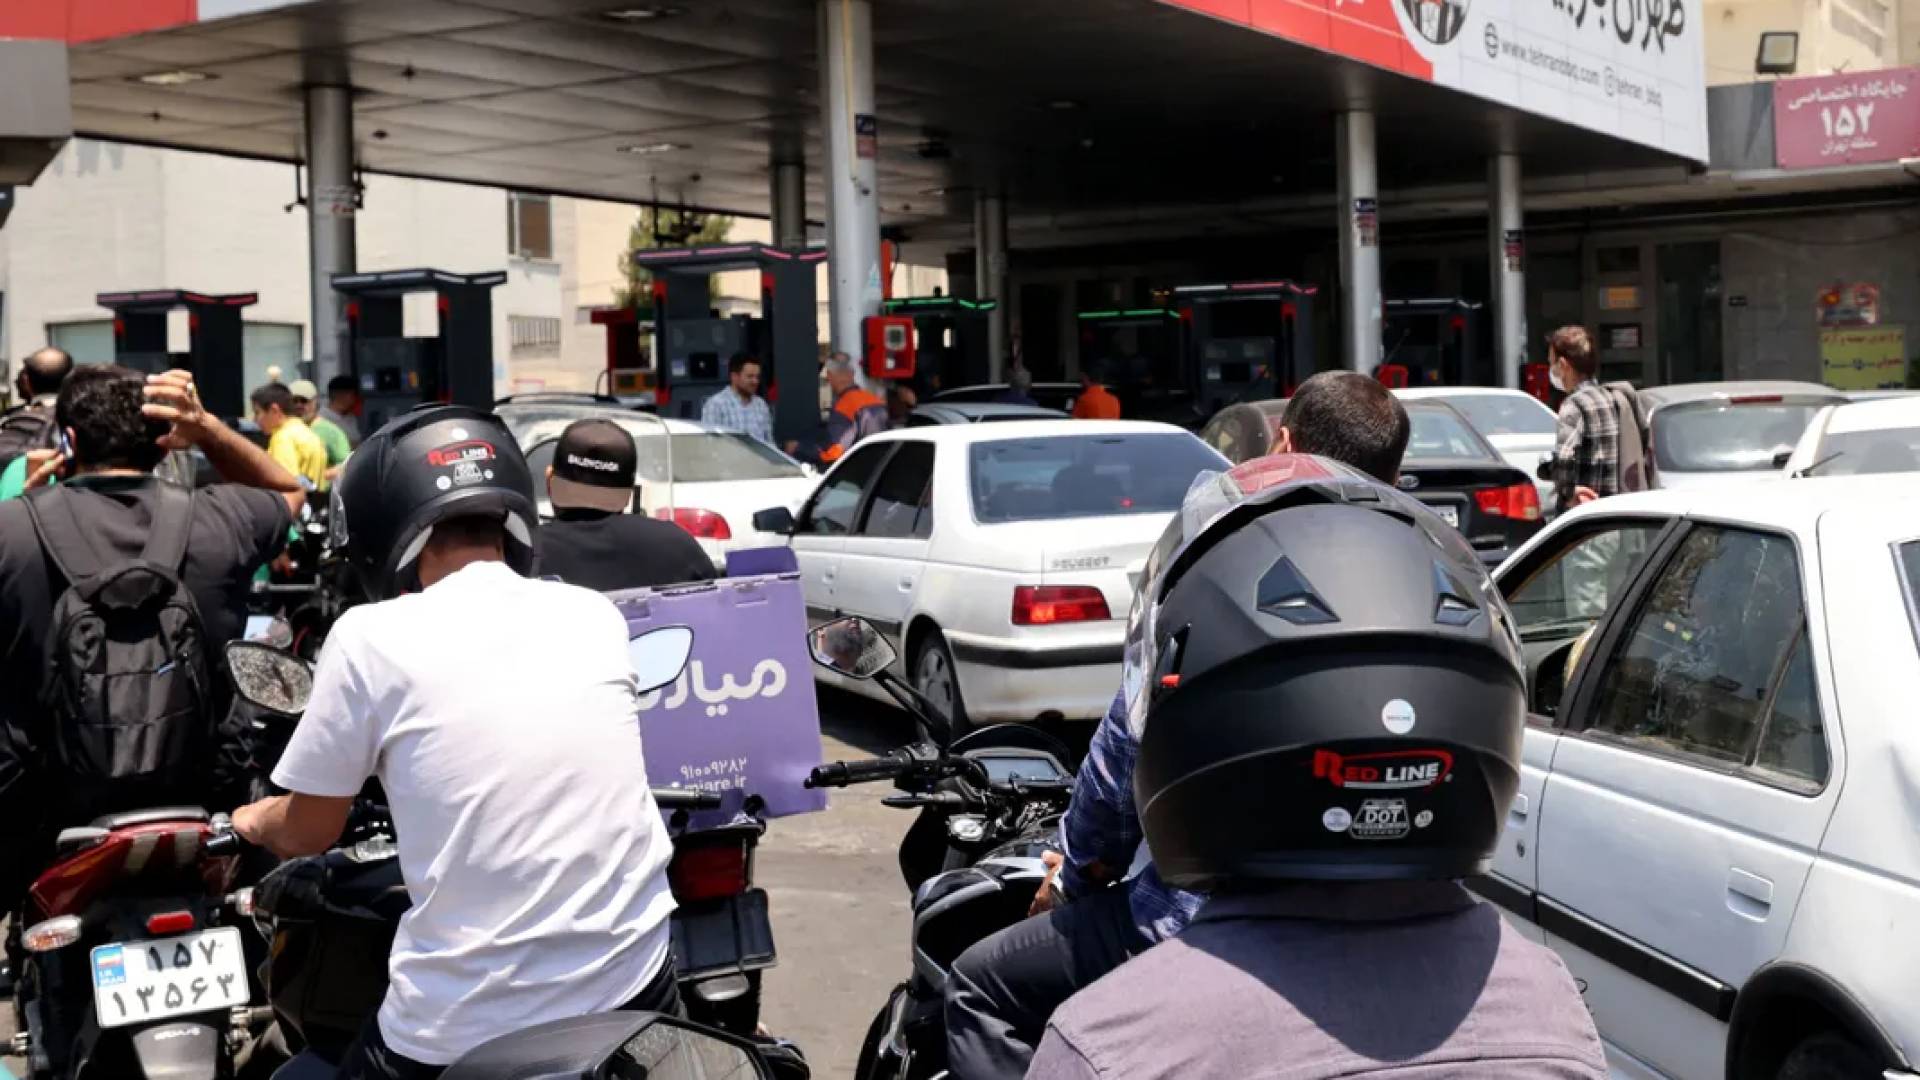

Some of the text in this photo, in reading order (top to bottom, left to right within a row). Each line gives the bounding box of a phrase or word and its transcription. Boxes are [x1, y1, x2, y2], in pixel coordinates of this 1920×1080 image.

[1788, 79, 1907, 109] جایگاه اختصاصی
[1822, 101, 1875, 137] ۱۵۲
[1385, 762, 1440, 781] LINE
[1365, 808, 1401, 823] DOT
